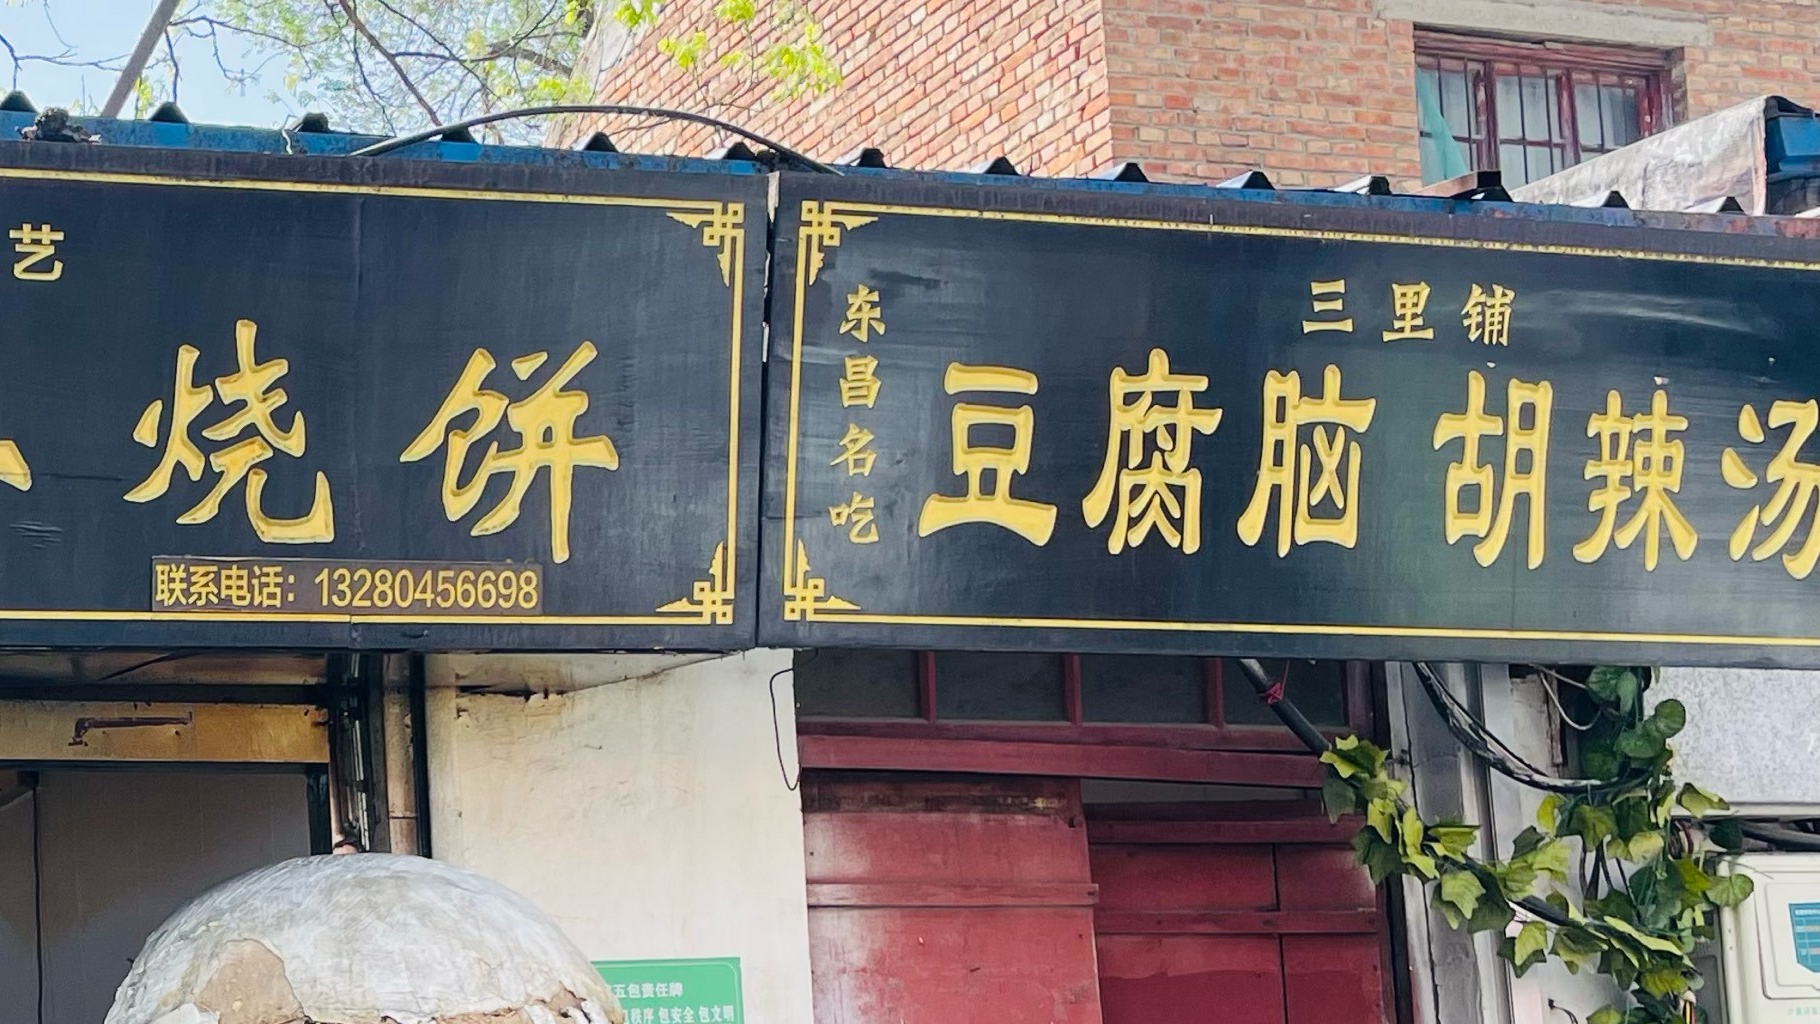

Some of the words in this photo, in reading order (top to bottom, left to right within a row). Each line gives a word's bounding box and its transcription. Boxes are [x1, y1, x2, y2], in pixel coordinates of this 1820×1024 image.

[828, 283, 887, 546] 东昌名吃
[1300, 279, 1516, 347] 三里铺
[917, 347, 1376, 557] 豆腐脑
